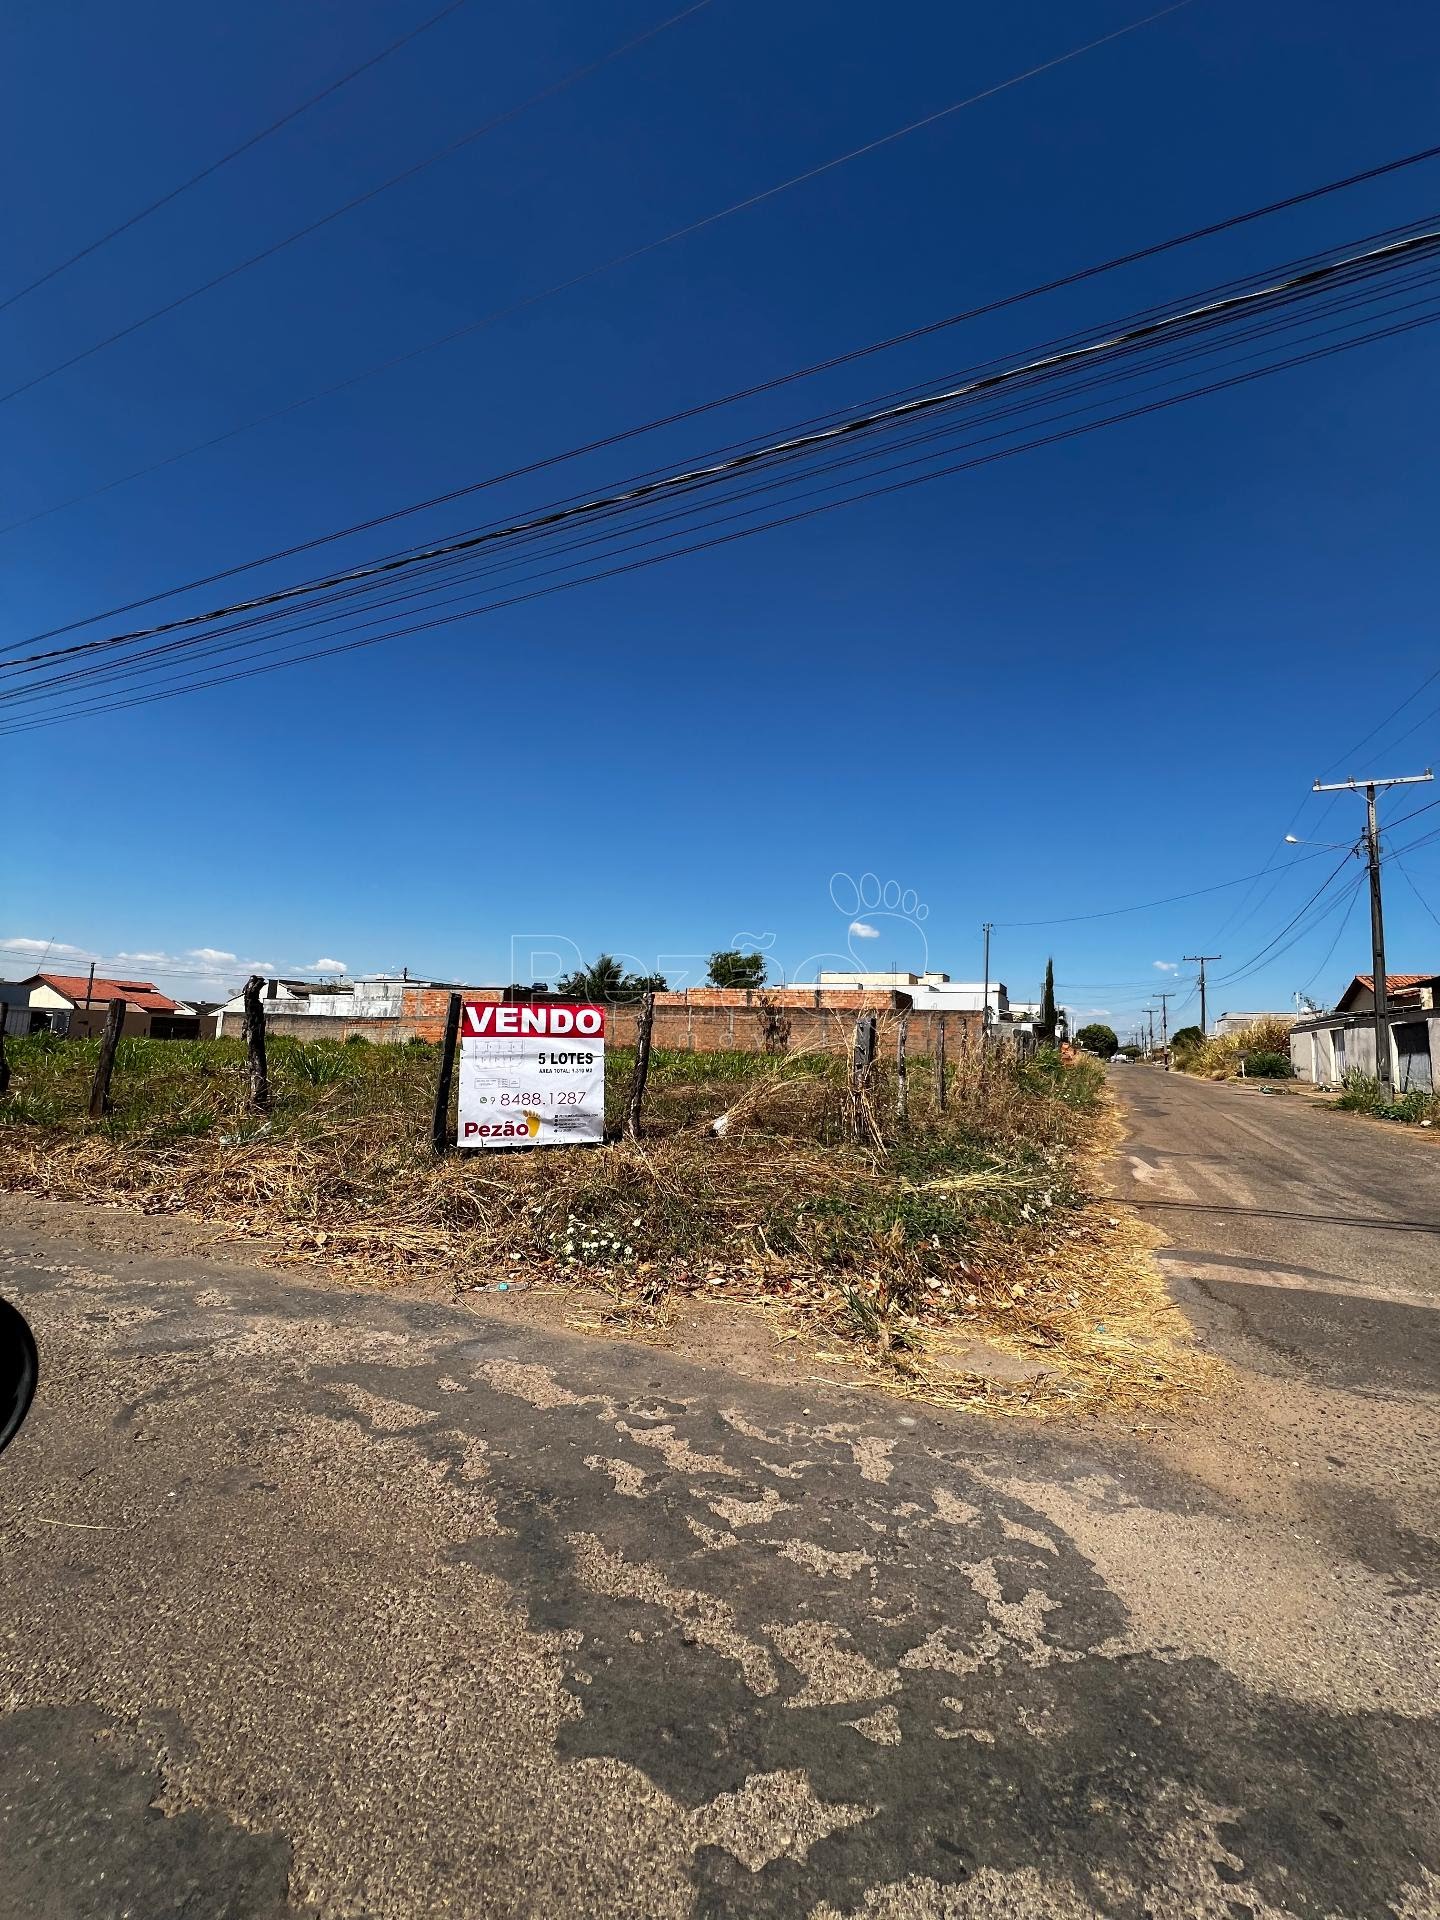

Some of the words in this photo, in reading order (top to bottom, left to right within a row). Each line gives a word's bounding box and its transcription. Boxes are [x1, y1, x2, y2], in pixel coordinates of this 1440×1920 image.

[465, 1007, 602, 1034] VENDO
[538, 1052, 546, 1065] 5
[550, 1052, 594, 1065] LOTES
[490, 1096, 496, 1105] 9
[500, 1091, 587, 1106] 8488.1287
[464, 1121, 529, 1138] Pezão
